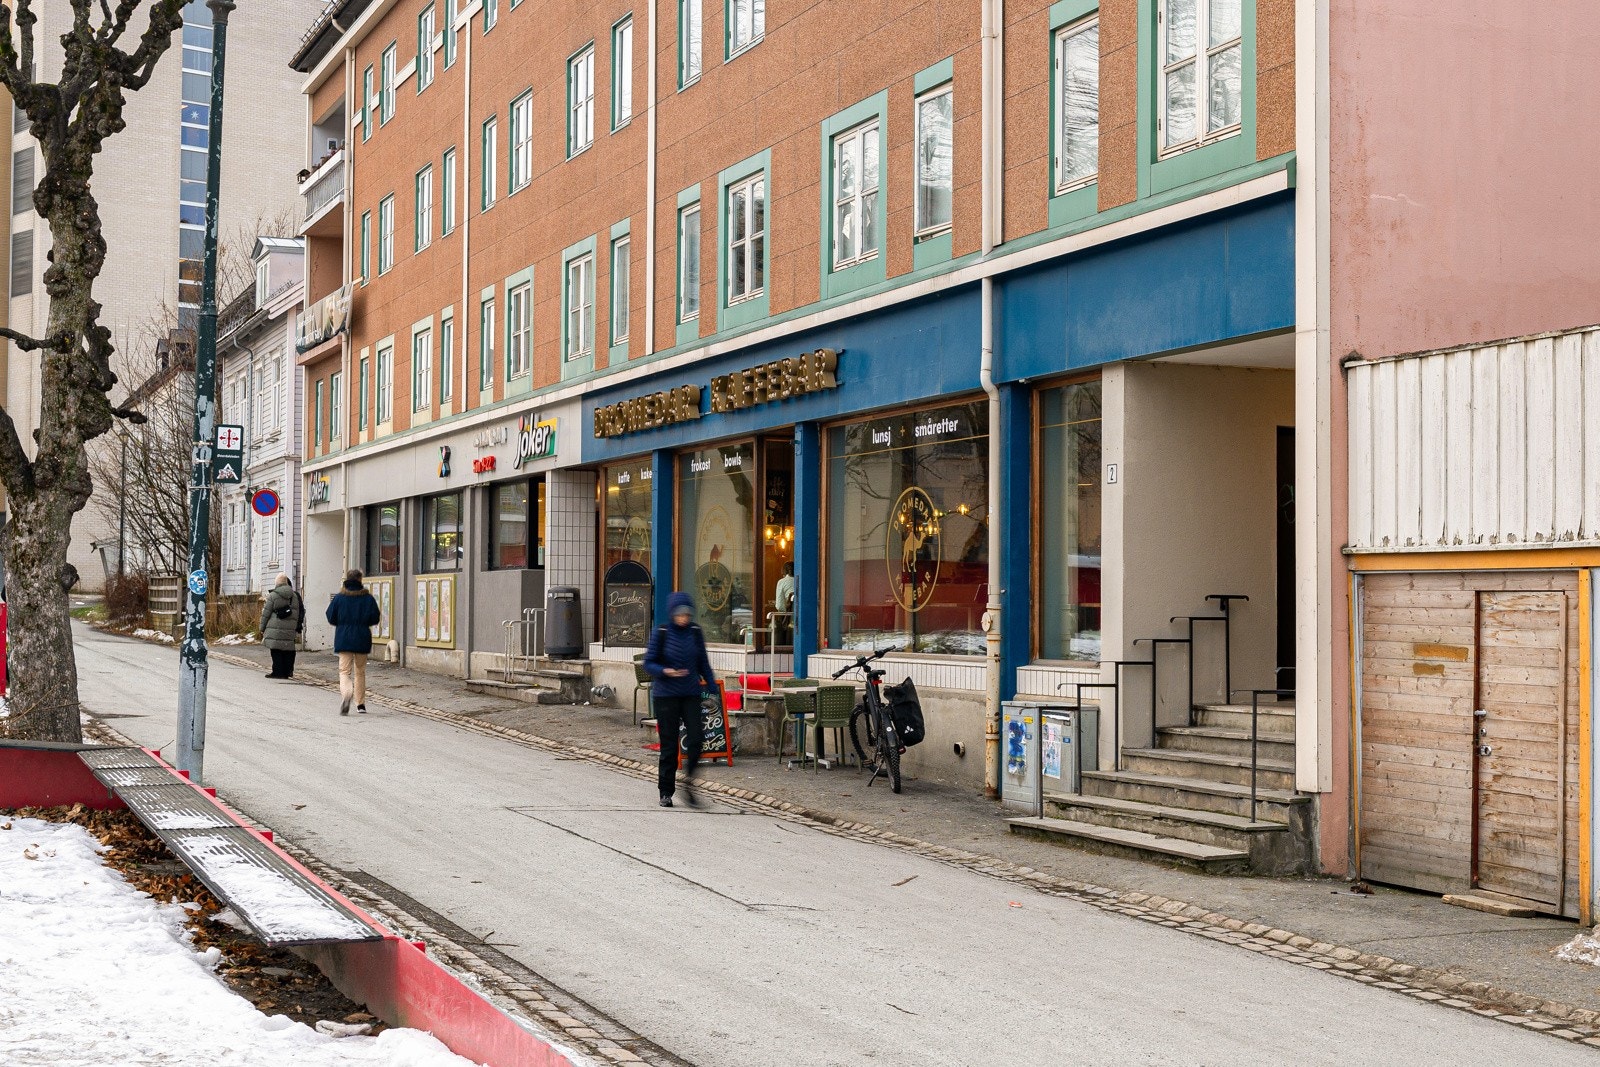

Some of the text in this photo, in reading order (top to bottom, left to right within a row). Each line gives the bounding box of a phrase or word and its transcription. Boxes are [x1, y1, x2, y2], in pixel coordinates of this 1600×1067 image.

[594, 348, 837, 438] DROMEDAR KAFFEBAR
[513, 413, 550, 470] joker
[872, 426, 891, 446] lunsj
[914, 418, 959, 437] småretter
[690, 452, 742, 473] frokost bowls
[1109, 467, 1115, 481] 2
[617, 466, 652, 484] kaffe kake
